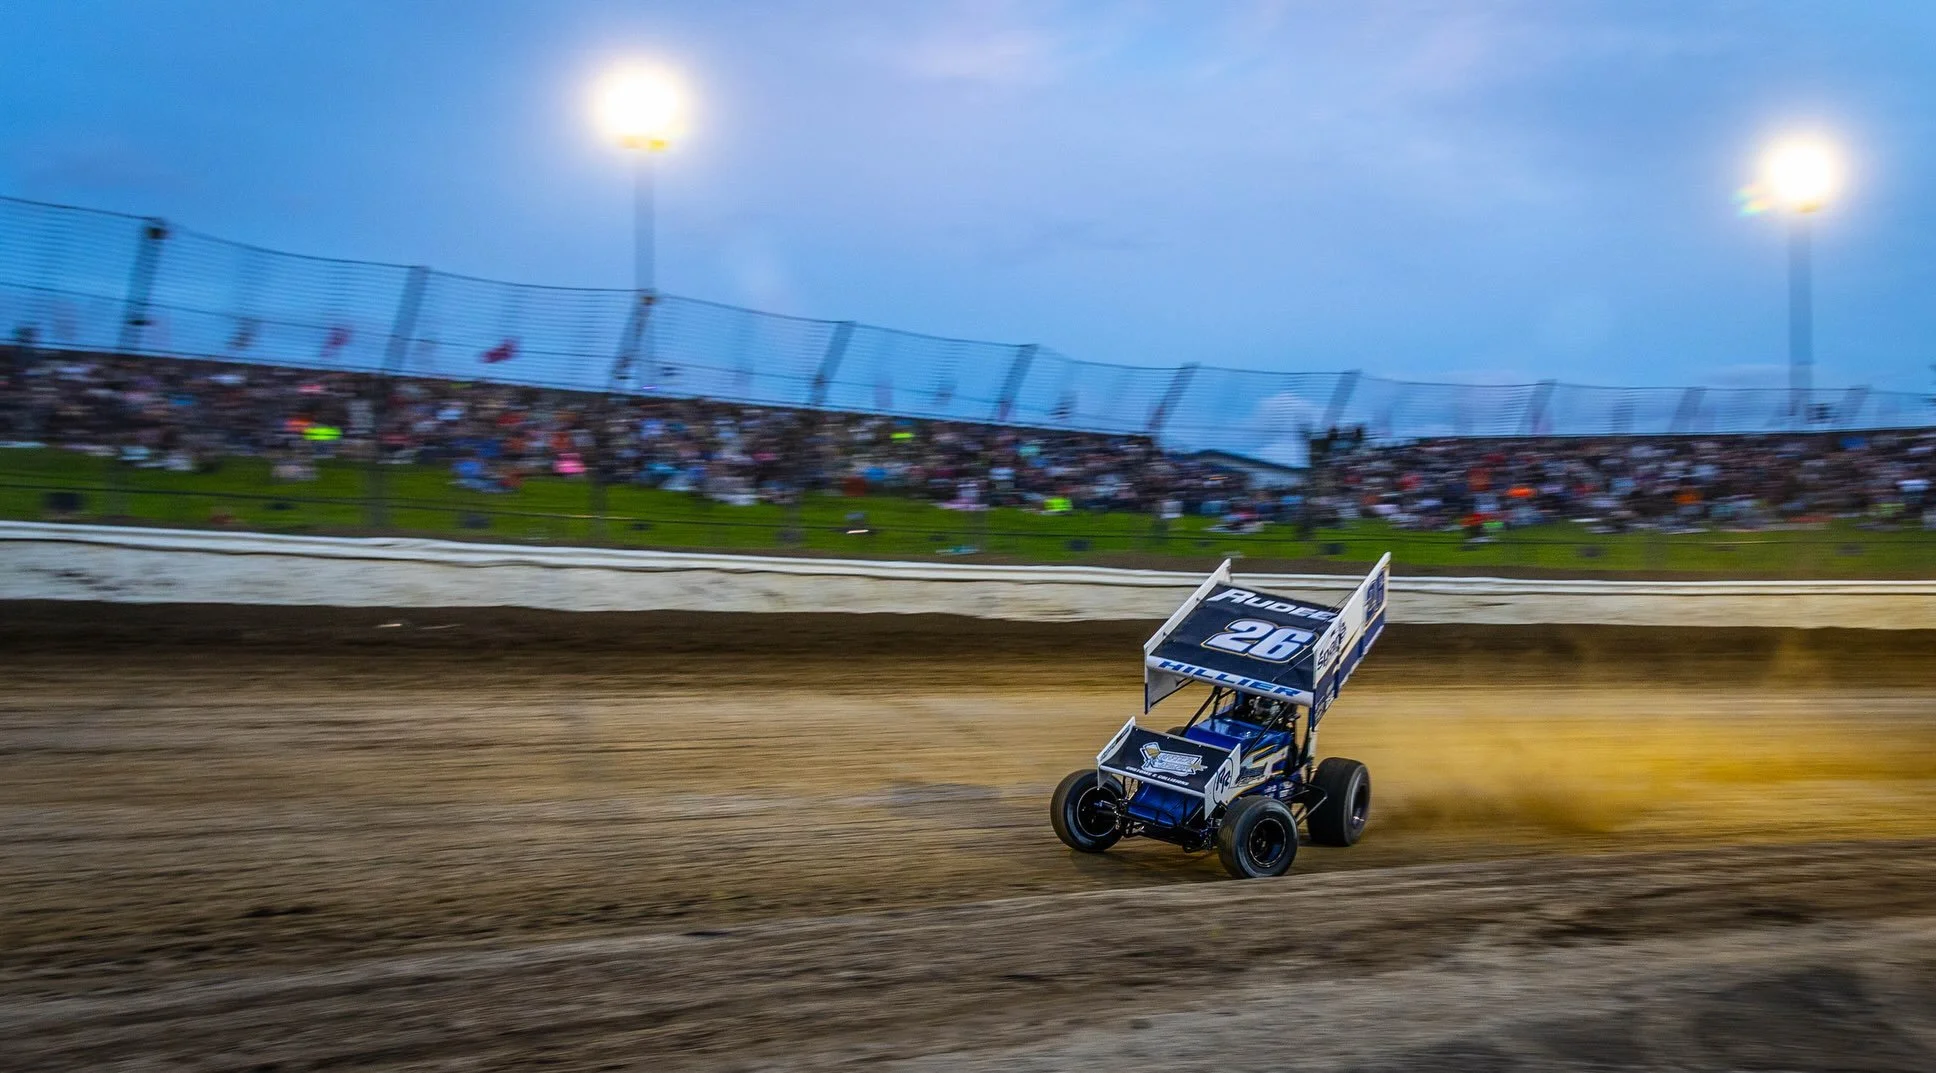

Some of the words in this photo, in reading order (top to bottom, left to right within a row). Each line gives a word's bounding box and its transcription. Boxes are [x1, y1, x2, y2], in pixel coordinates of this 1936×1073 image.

[1206, 588, 1338, 622] RUDEE
[1201, 618, 1319, 662] 26
[1158, 661, 1301, 697] HILLIER
